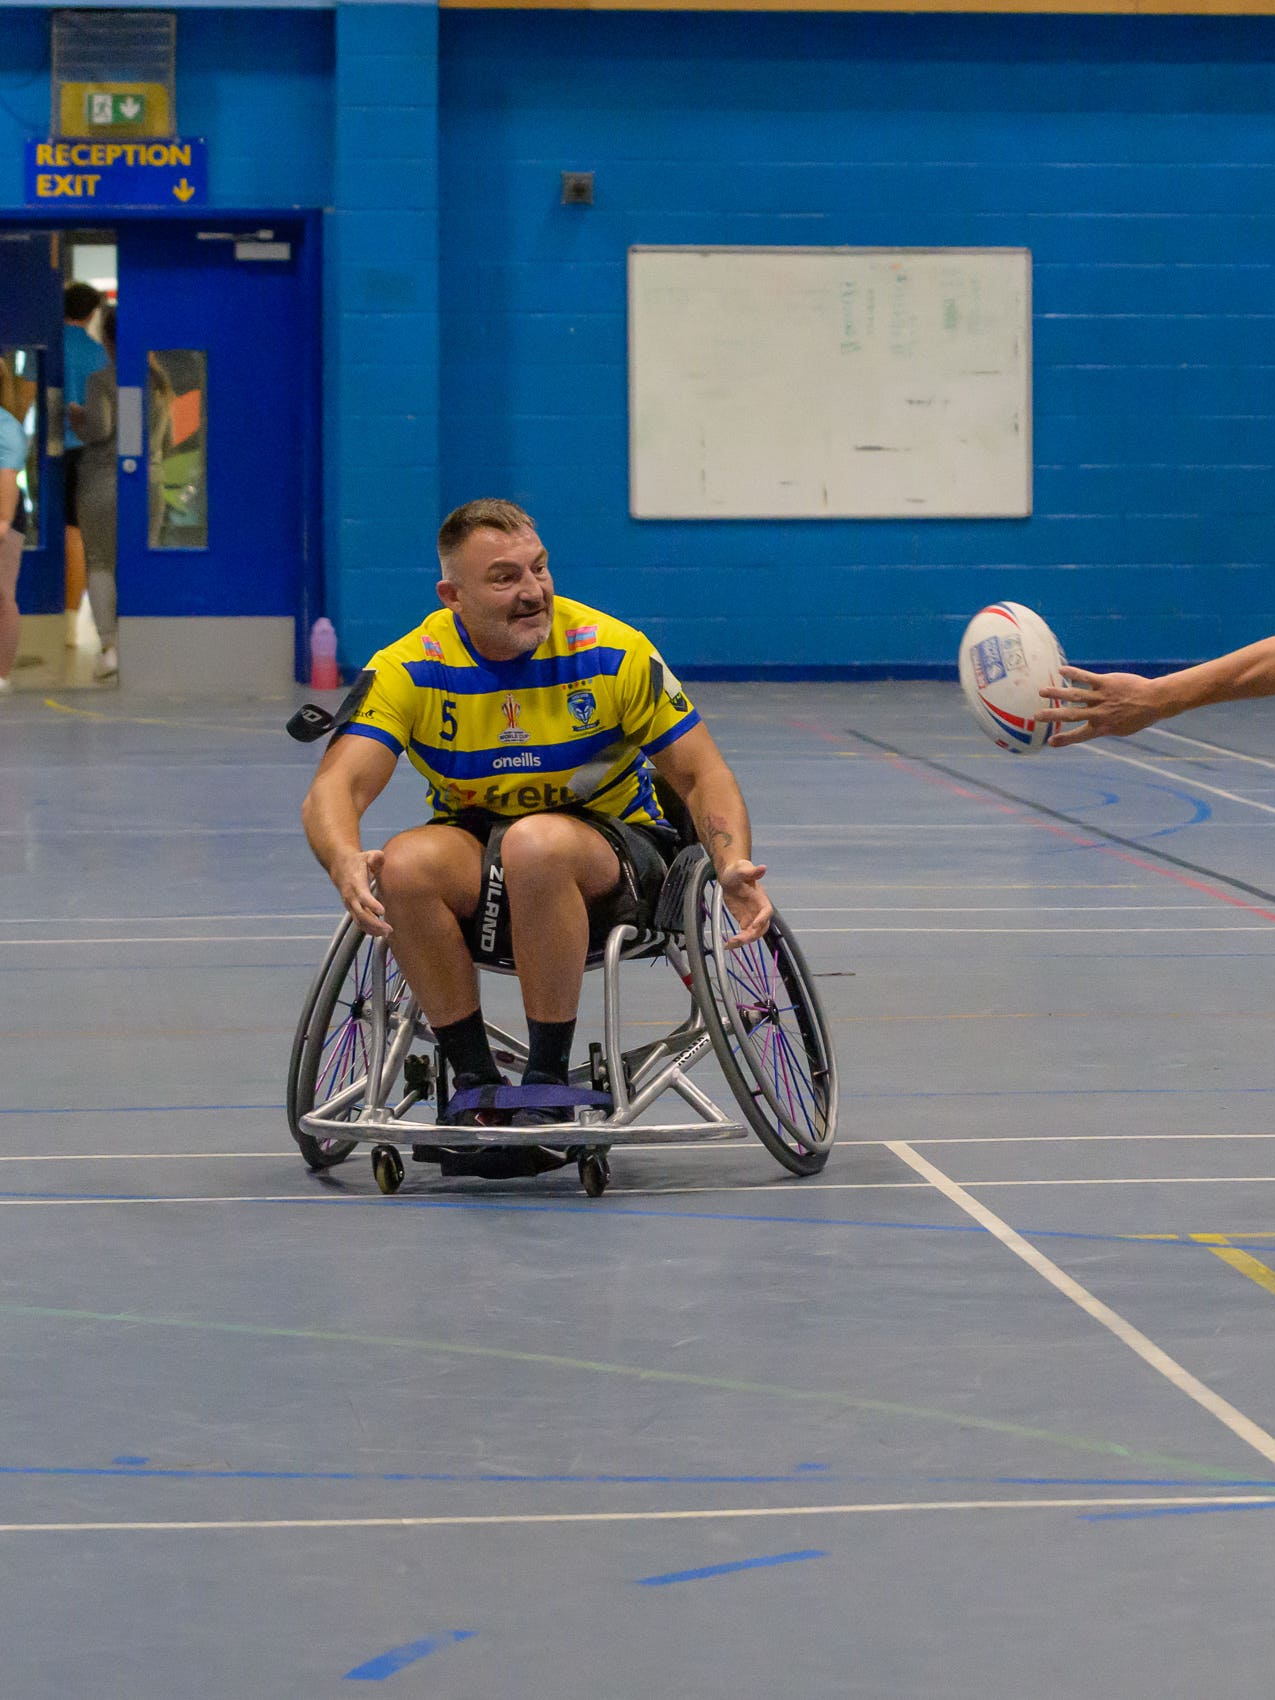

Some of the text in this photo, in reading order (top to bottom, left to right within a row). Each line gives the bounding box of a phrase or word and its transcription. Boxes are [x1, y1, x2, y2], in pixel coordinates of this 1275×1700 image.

[36, 143, 191, 166] RECEPTION
[36, 174, 100, 197] EXIT
[439, 700, 458, 741] 5
[480, 864, 504, 953] ZILAND
